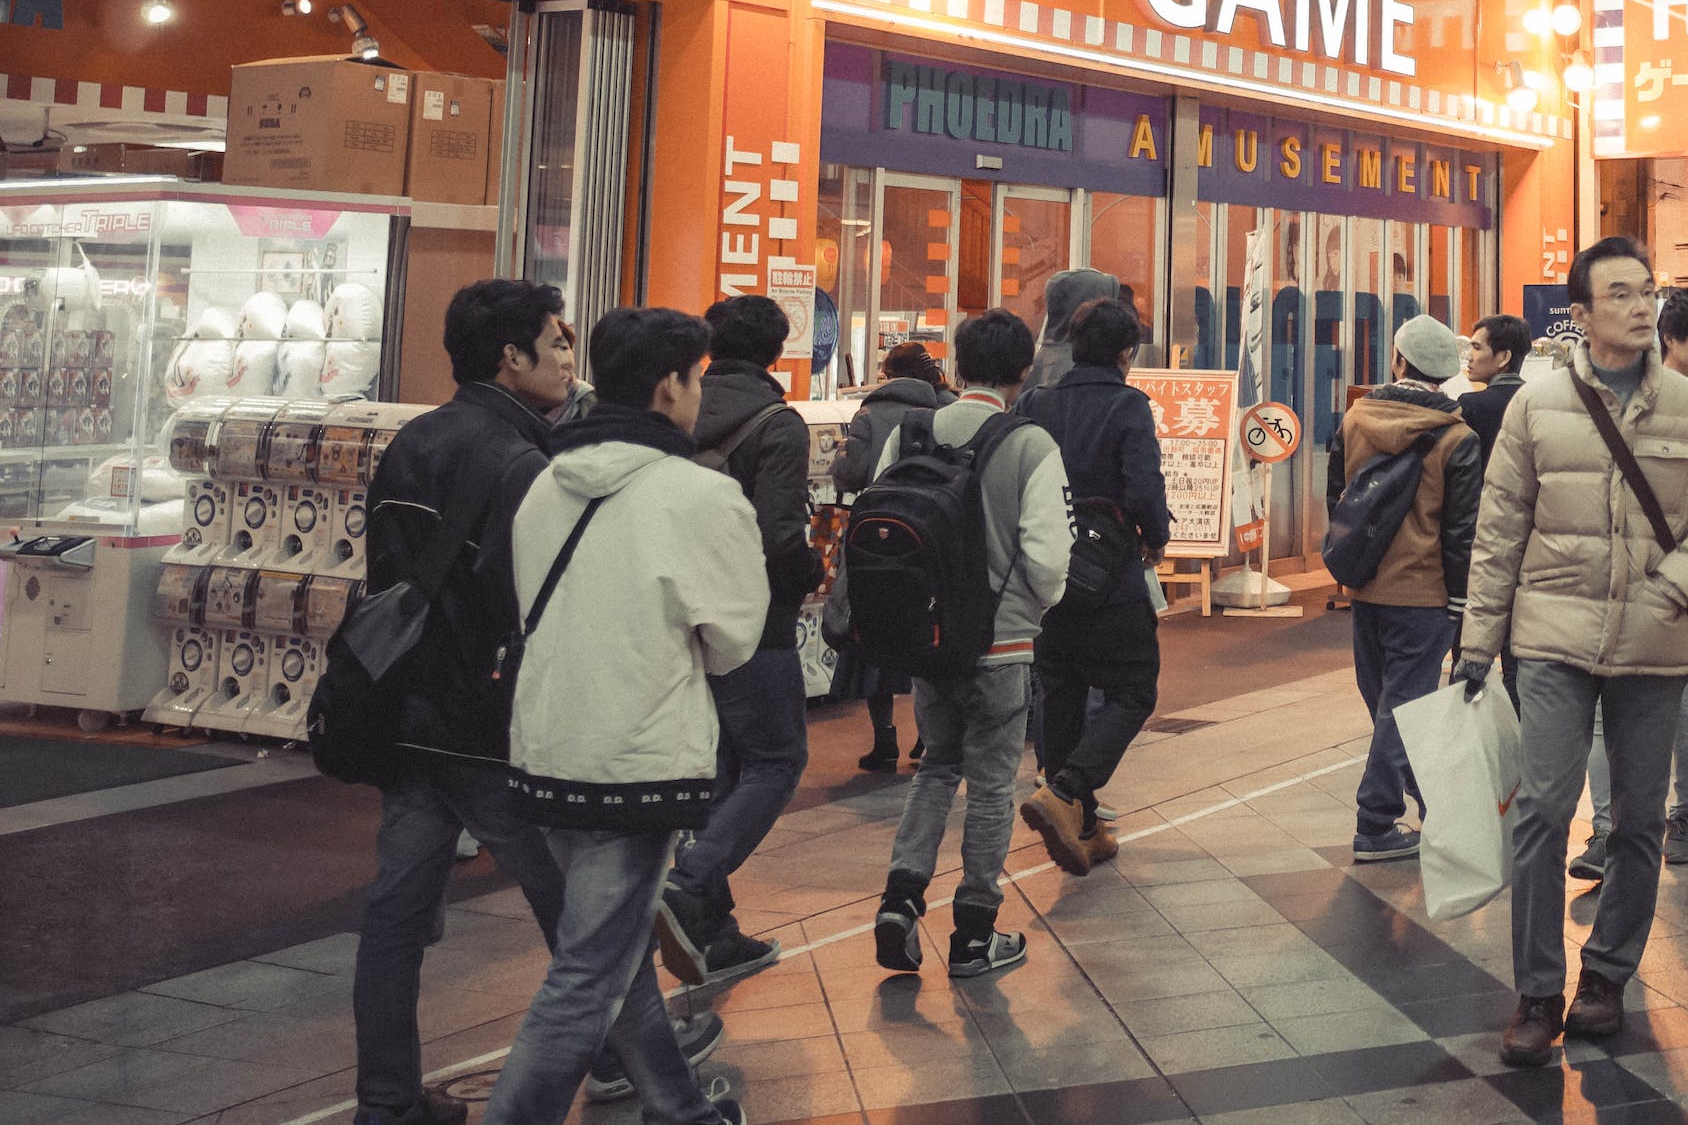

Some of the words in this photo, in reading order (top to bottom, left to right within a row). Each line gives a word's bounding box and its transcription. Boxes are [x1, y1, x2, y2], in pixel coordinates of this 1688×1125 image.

[886, 61, 1074, 152] PHOEDRA
[1128, 113, 1483, 203] AMUSEMENT
[772, 270, 814, 286] 駐輪禁止
[1546, 319, 1585, 338] COFFE
